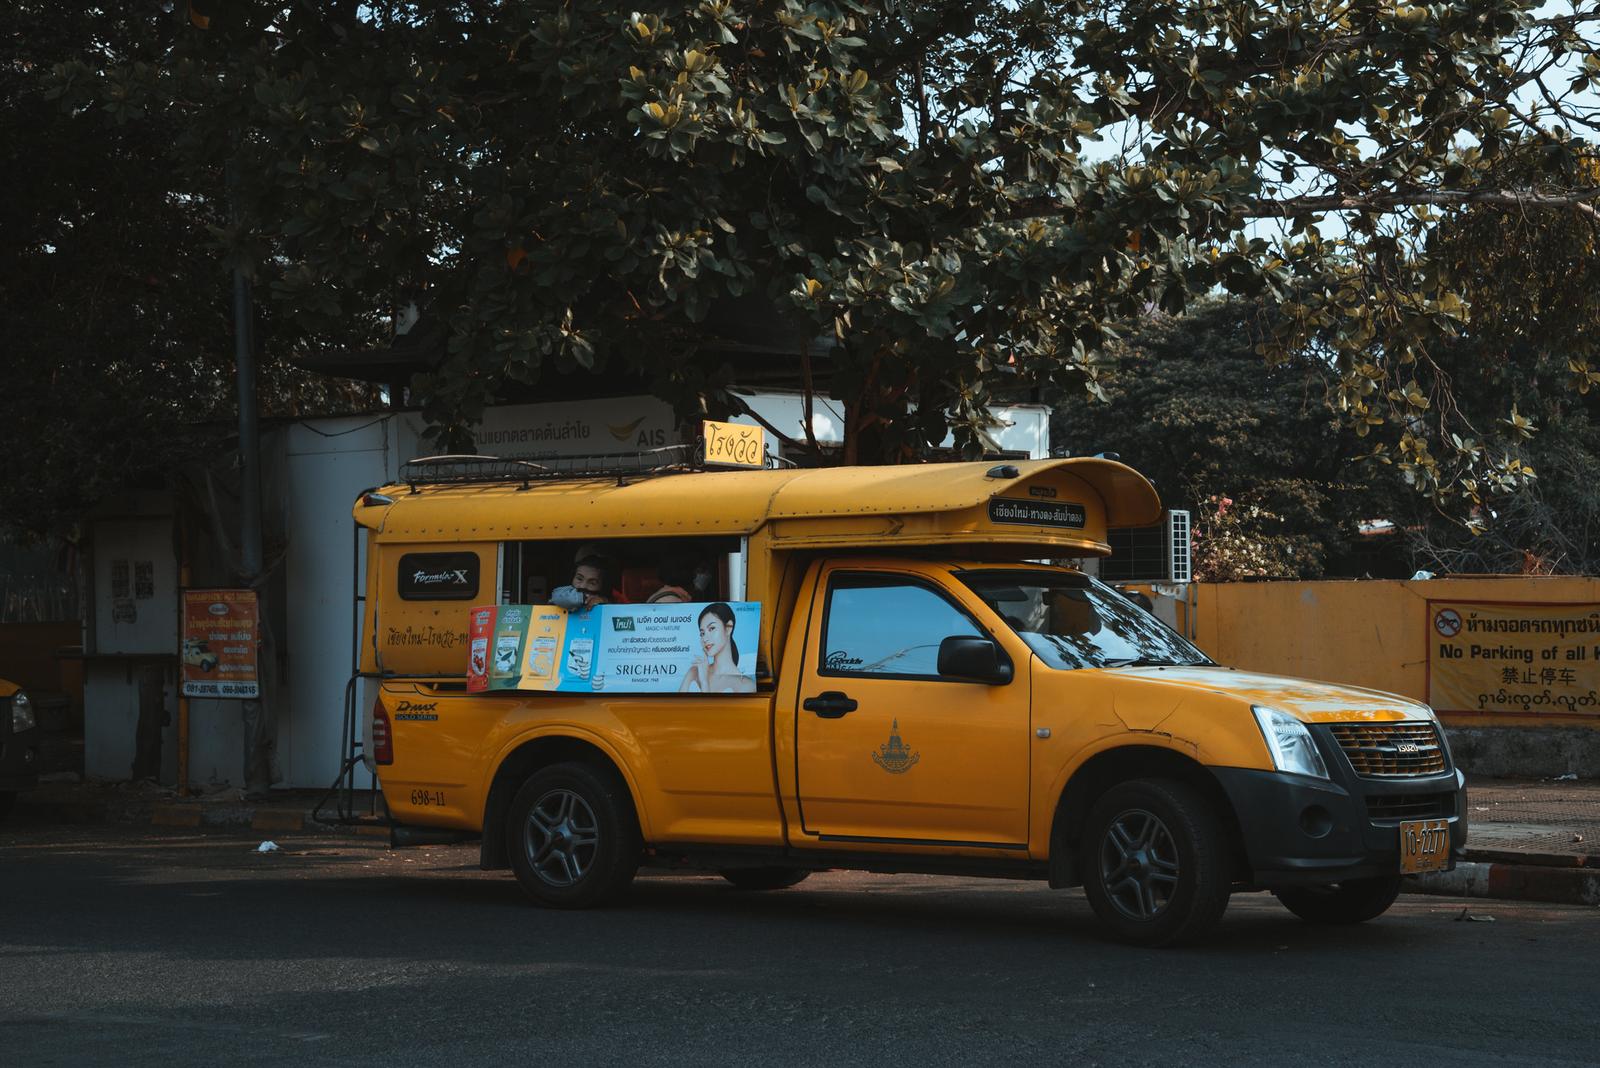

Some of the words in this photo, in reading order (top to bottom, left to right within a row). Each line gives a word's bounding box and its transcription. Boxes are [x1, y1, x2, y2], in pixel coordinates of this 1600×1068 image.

[471, 420, 591, 445] ามแยกตลาดต้นลำไย
[637, 430, 666, 447] AIS
[709, 423, 758, 464] โรงวัว
[1440, 643, 1463, 659] No
[1471, 645, 1533, 663] Parking
[1542, 646, 1558, 661] of
[1566, 646, 1586, 661] all
[615, 664, 678, 676] SRICHAND
[1502, 667, 1577, 686] 禁止停车
[411, 789, 447, 806] 698-11
